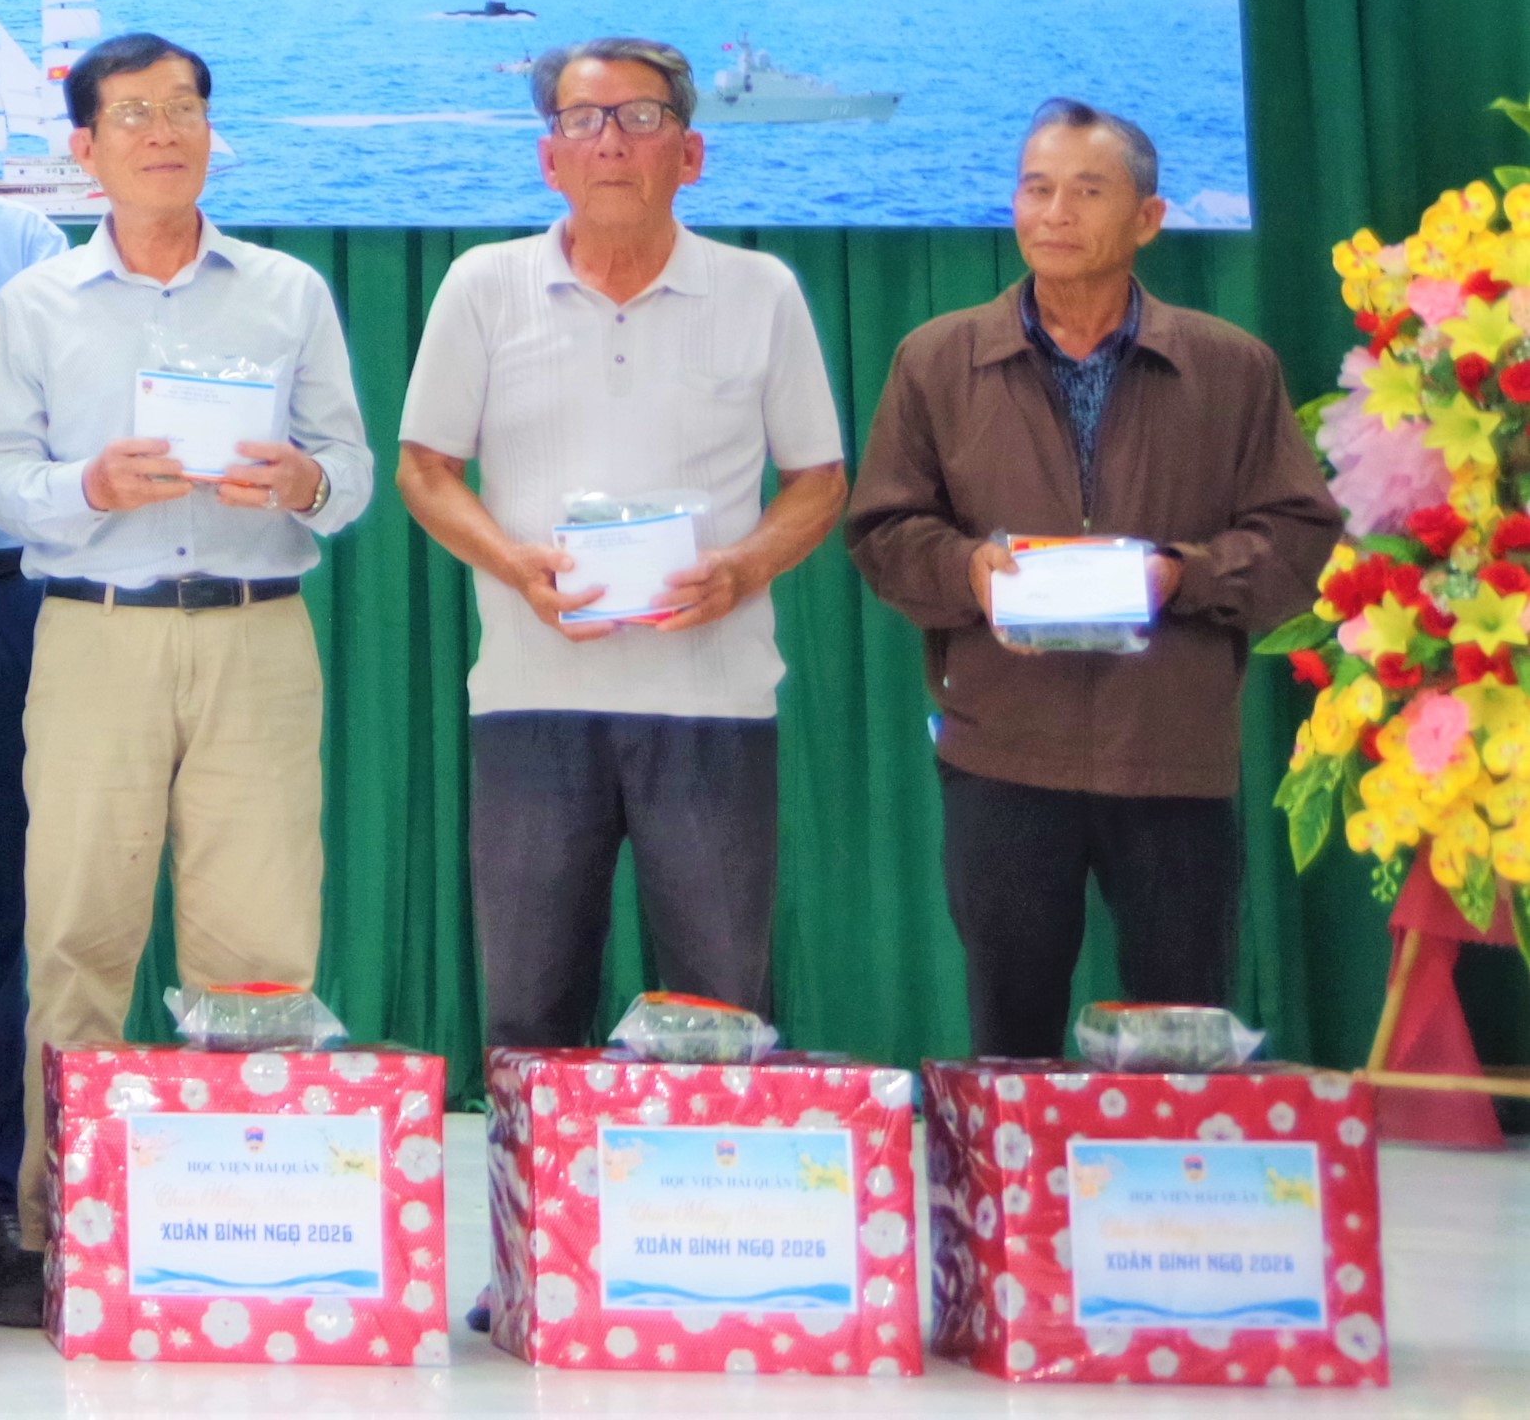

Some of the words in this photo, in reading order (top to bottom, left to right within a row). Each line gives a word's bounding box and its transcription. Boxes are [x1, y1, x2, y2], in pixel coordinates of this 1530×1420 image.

[160, 1217, 208, 1241] XUÂN
[215, 1218, 257, 1241] BÍNH
[263, 1223, 300, 1246] NGỌ
[307, 1224, 353, 1243] 2026
[635, 1233, 682, 1256] XUÂN
[689, 1235, 731, 1257] BÍNH
[737, 1239, 774, 1261] NGỌ
[781, 1240, 826, 1259] 2026
